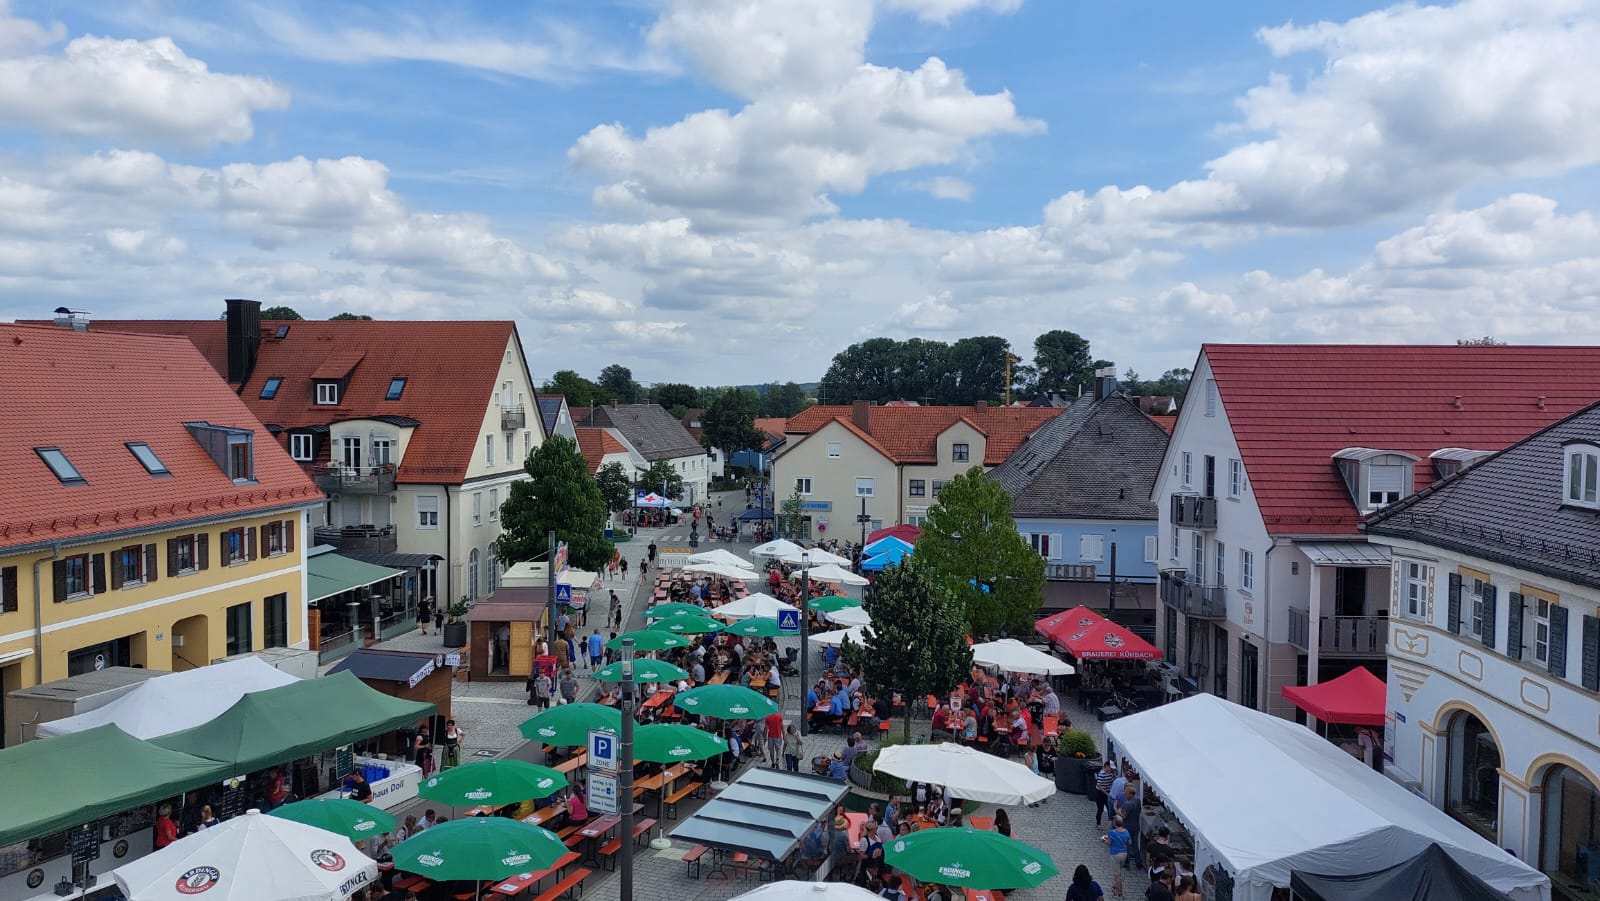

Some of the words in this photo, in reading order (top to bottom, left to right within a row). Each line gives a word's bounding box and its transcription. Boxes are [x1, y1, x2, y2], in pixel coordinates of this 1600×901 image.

[1119, 650, 1154, 658] KÜHBACH
[598, 739, 608, 755] P
[595, 759, 610, 767] ZONE
[390, 779, 404, 793] Doll
[184, 866, 218, 881] ERDINGER
[939, 866, 971, 877] ERDINGER
